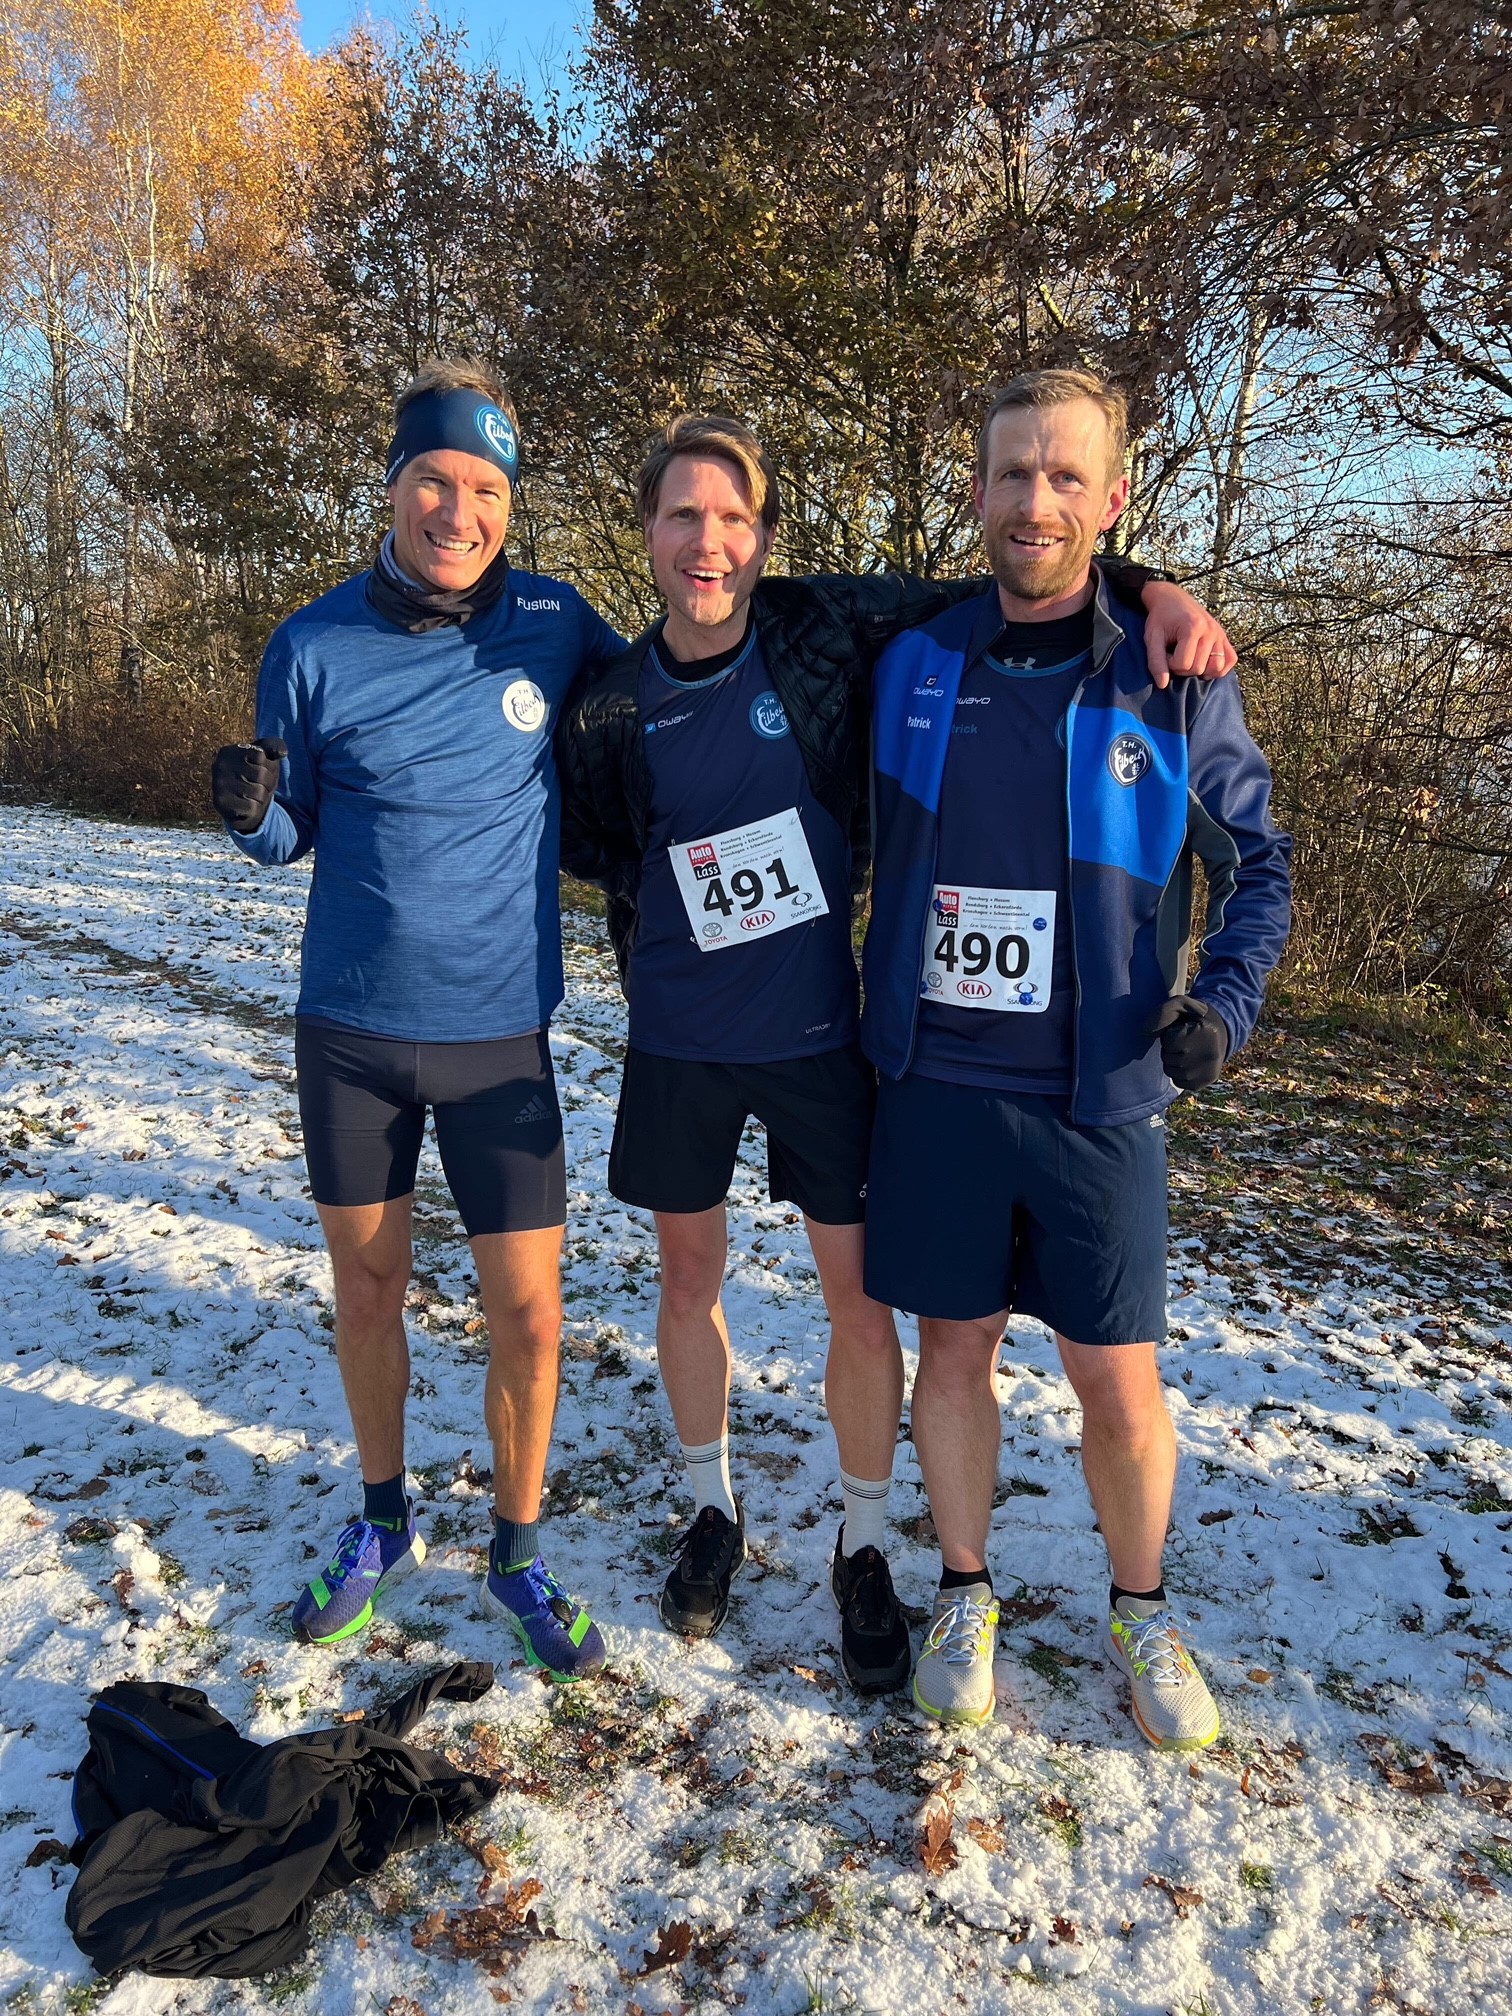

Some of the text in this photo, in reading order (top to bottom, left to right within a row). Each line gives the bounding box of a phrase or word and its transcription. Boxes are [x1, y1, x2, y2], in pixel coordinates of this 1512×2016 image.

[516, 596, 561, 611] FUSION
[907, 716, 931, 729] Patrick
[952, 724, 978, 734] trick
[690, 846, 712, 860] Auto
[696, 865, 719, 878] Lass
[702, 857, 800, 917] 491
[939, 892, 957, 906] Auto
[746, 912, 770, 928] KIA
[938, 915, 957, 926] Lass
[704, 936, 728, 946] TOYOTA
[934, 929, 1030, 979] 490
[962, 983, 986, 996] KIA
